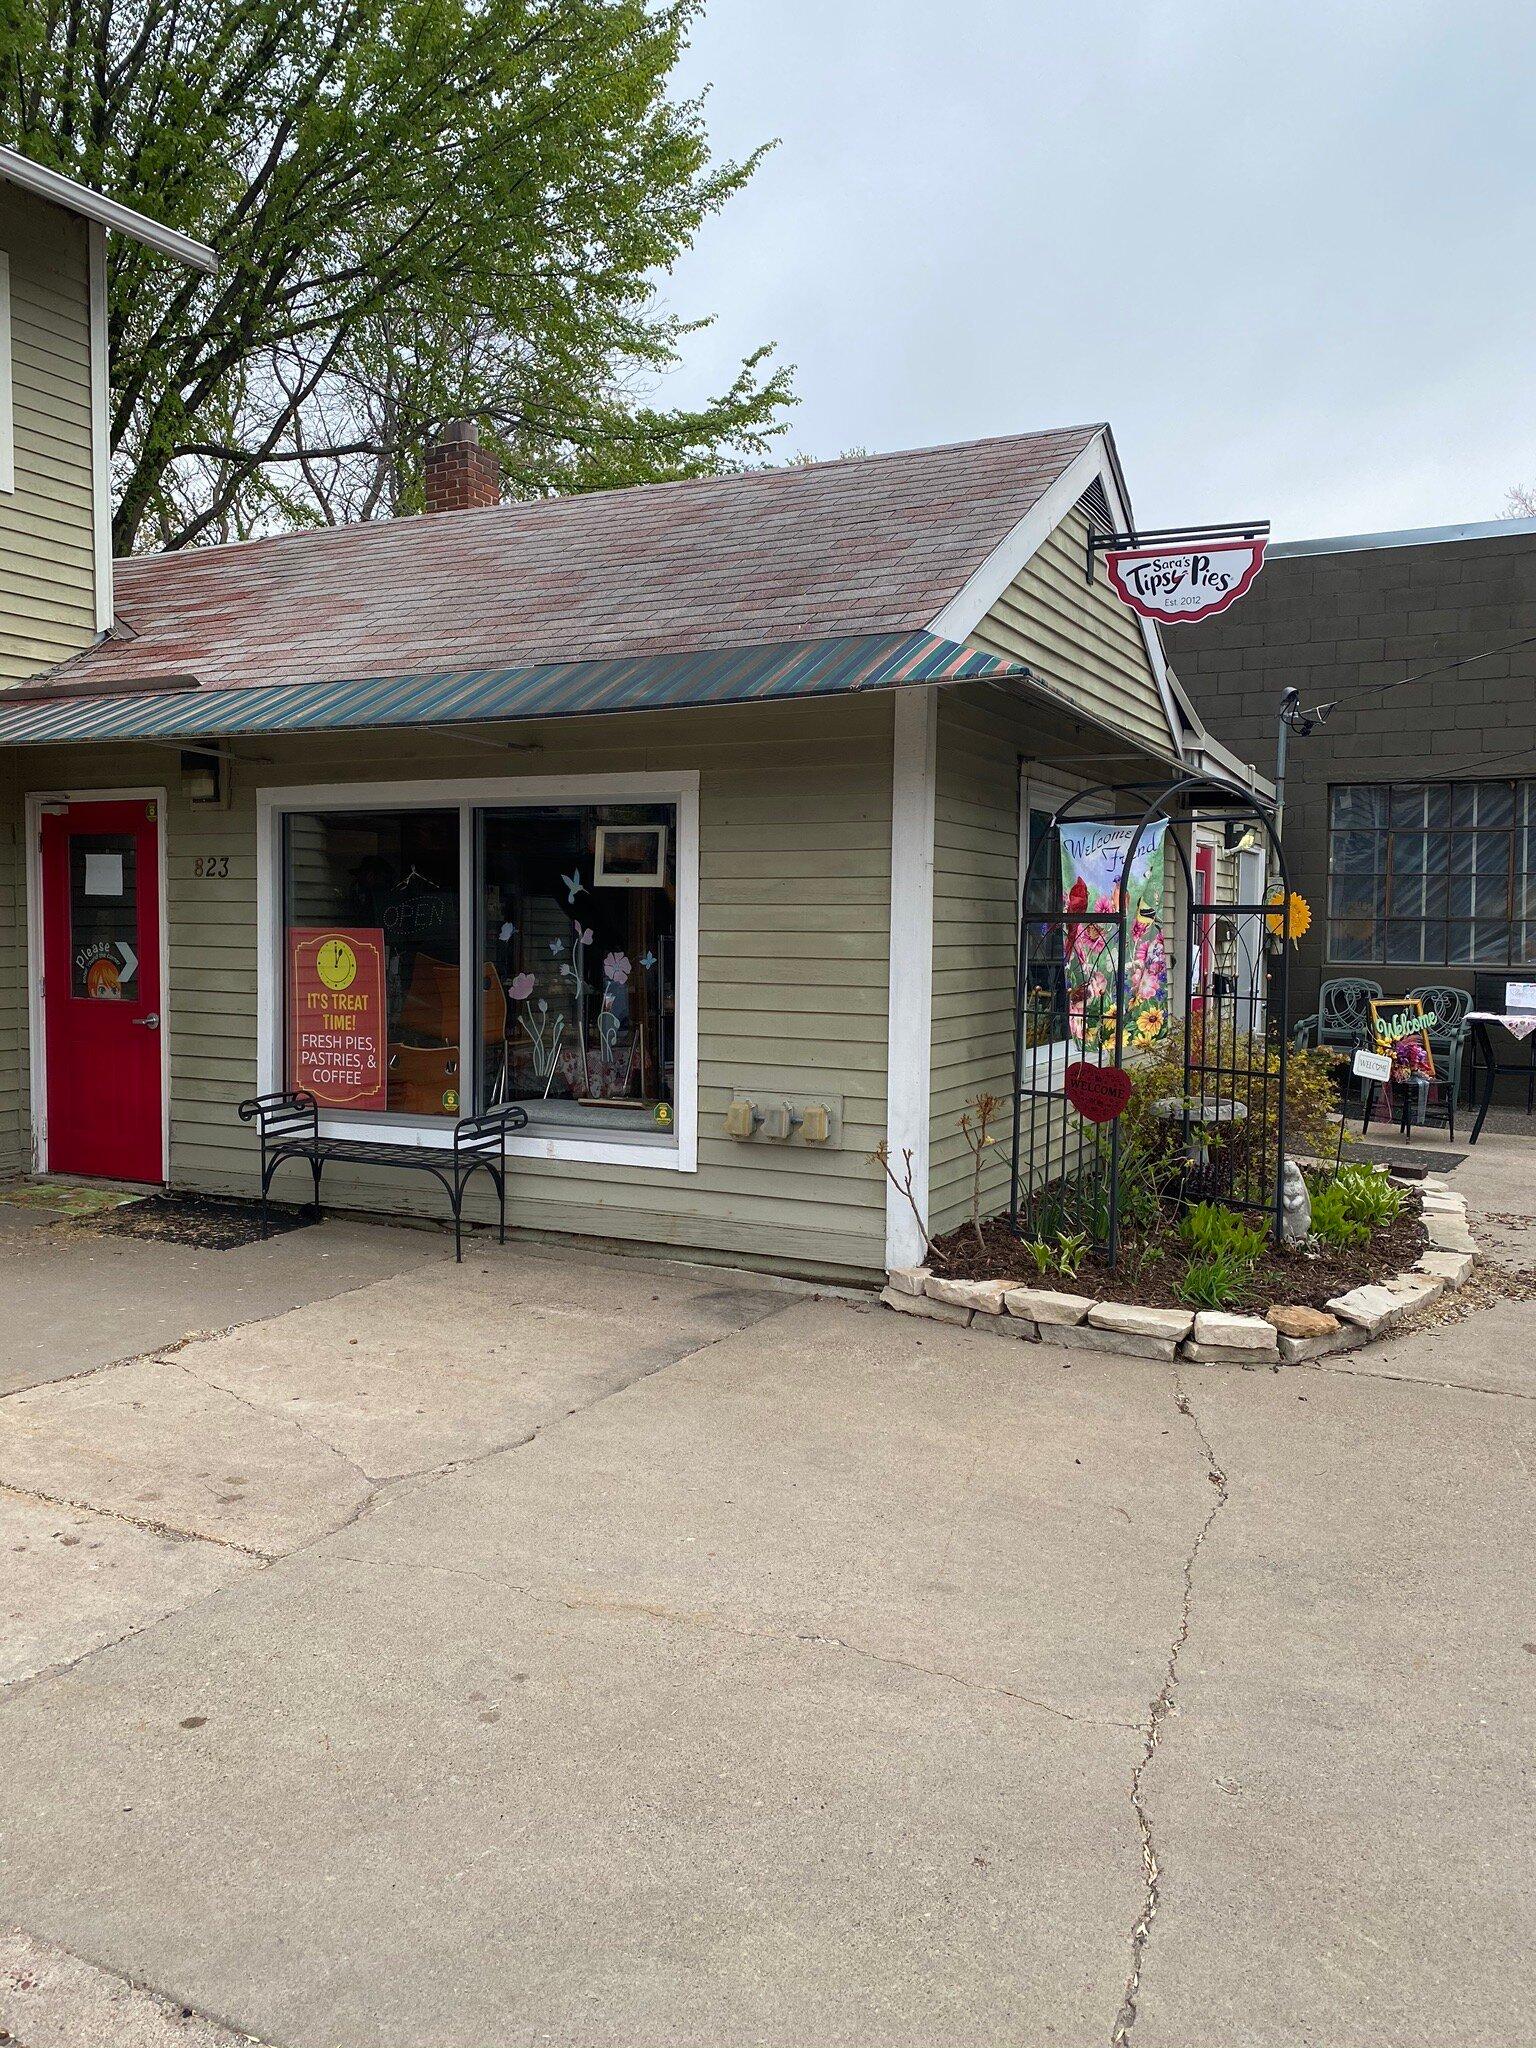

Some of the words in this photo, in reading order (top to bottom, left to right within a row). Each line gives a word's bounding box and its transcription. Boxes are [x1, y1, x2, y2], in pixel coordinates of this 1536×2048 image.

[1153, 556, 1190, 572] Sara's
[1126, 563, 1188, 596] Tipsy
[1192, 556, 1231, 592] Pies
[1164, 598, 1178, 607] Est.
[1180, 596, 1201, 606] 2012
[1064, 829, 1132, 859] Welcome
[1102, 831, 1157, 872] Frnd
[194, 857, 229, 878] 823
[383, 902, 444, 927] OPEN
[307, 992, 328, 1009] IT'S
[331, 994, 369, 1011] TREAT
[322, 1013, 356, 1030] TIME!
[1376, 1011, 1438, 1039] Welcome
[302, 1034, 342, 1048] FRESH
[345, 1036, 376, 1053] PIES,
[301, 1051, 364, 1070] PASTRIES,
[367, 1054, 377, 1069] &
[312, 1069, 362, 1085] COFFEE
[1070, 1079, 1125, 1099] WELCOME
